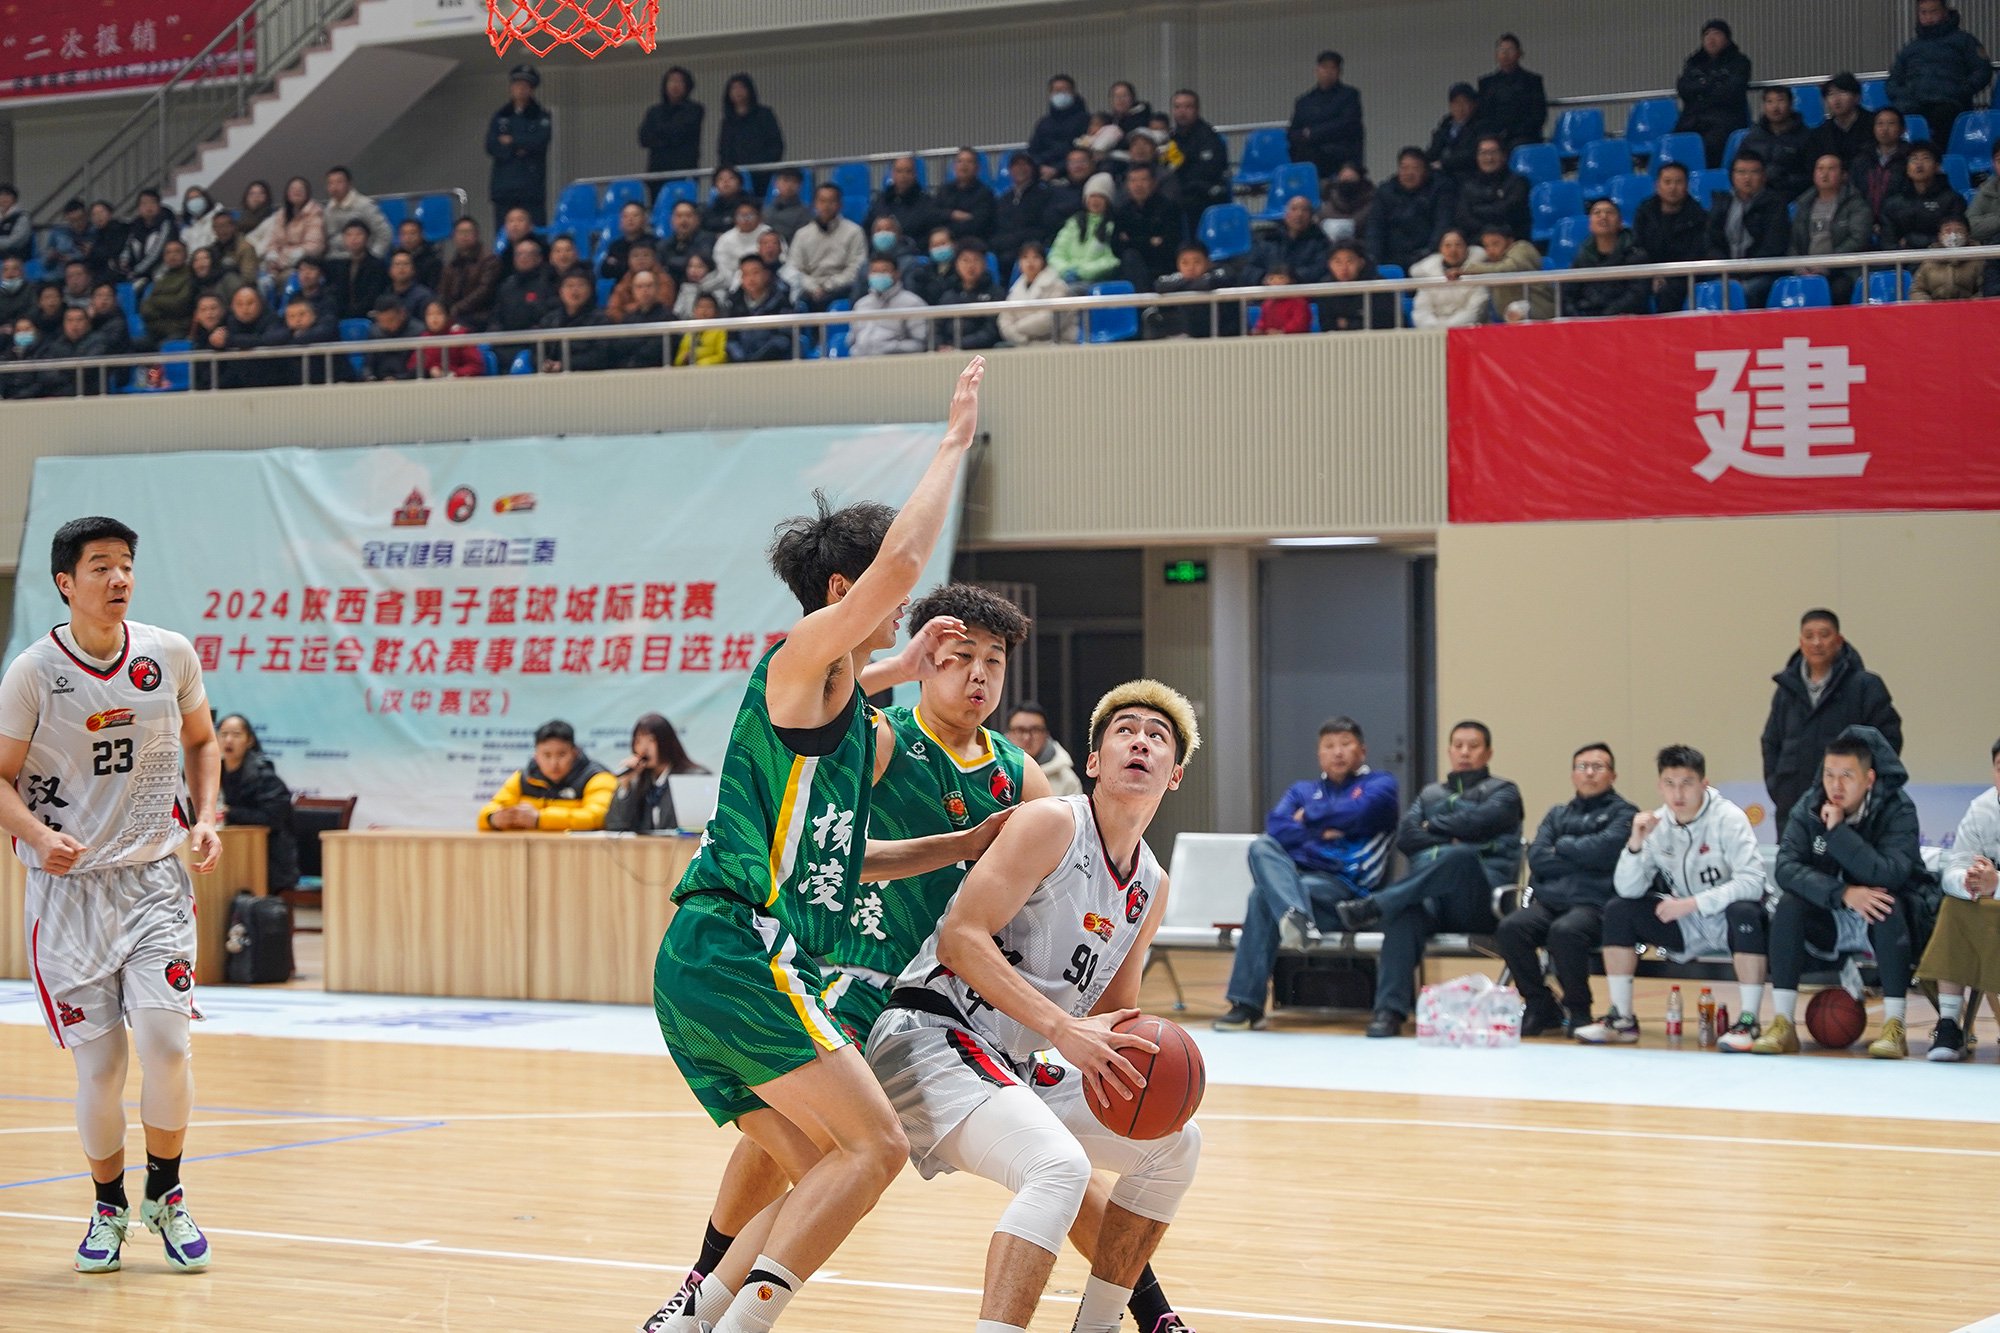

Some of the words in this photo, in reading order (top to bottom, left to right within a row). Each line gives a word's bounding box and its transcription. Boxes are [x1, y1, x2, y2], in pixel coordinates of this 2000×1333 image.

[1691, 336, 1872, 483] 建
[362, 539, 454, 569] 全民健身
[462, 536, 558, 567] 运动三秦
[92, 737, 134, 776] 23
[797, 802, 854, 912] 杨凌
